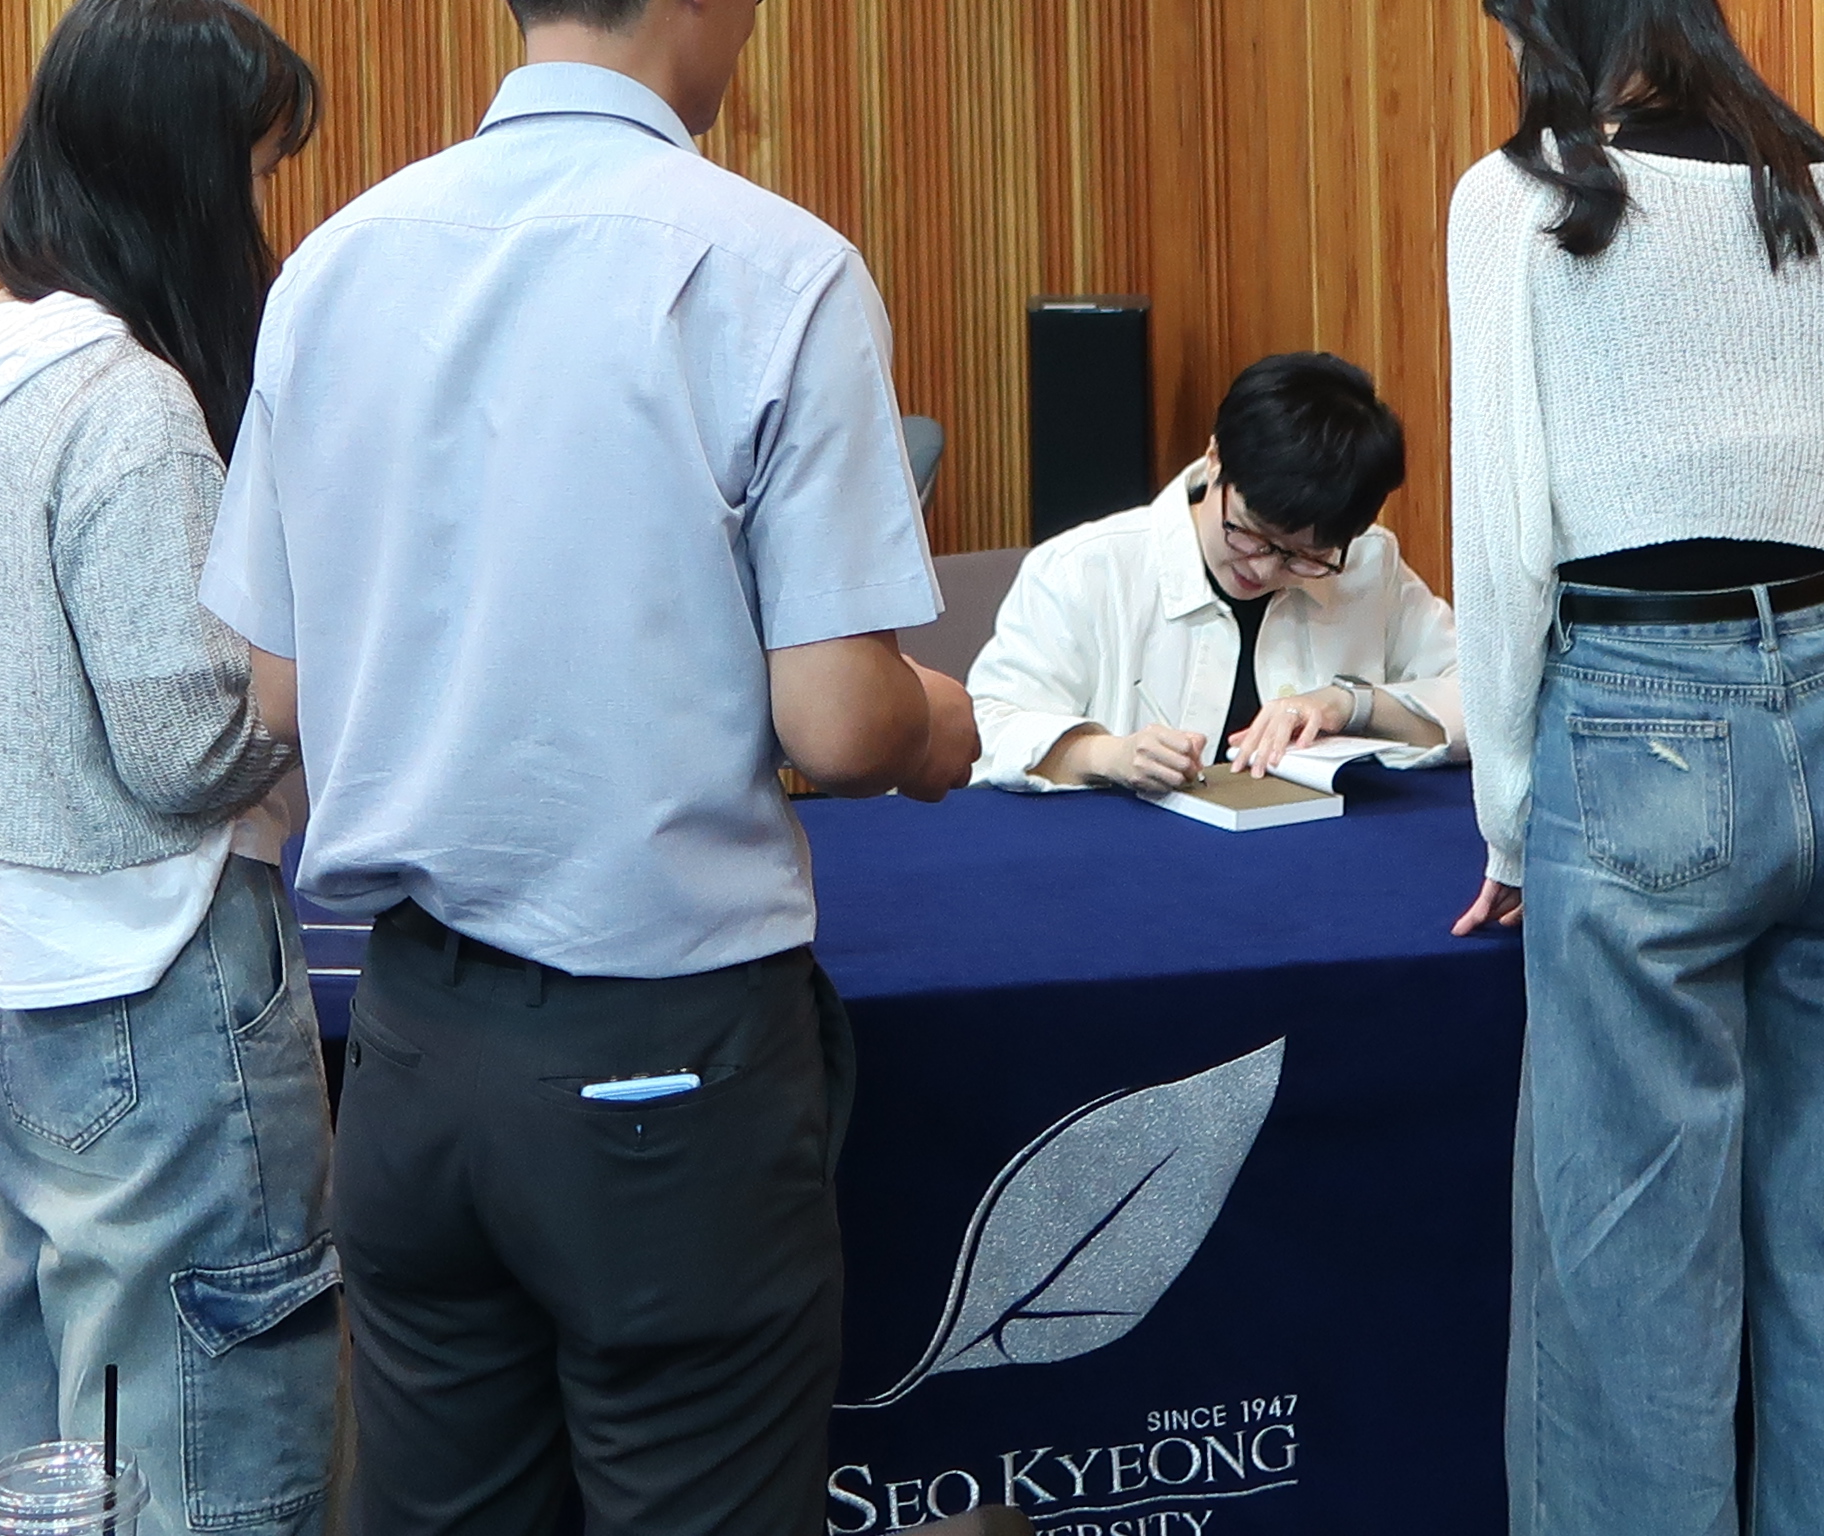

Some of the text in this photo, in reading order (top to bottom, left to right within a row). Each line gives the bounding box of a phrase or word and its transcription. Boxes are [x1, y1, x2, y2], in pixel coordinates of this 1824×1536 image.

[1146, 1393, 1299, 1433] SINCE 1947
[997, 1423, 1301, 1508] KYEONG
